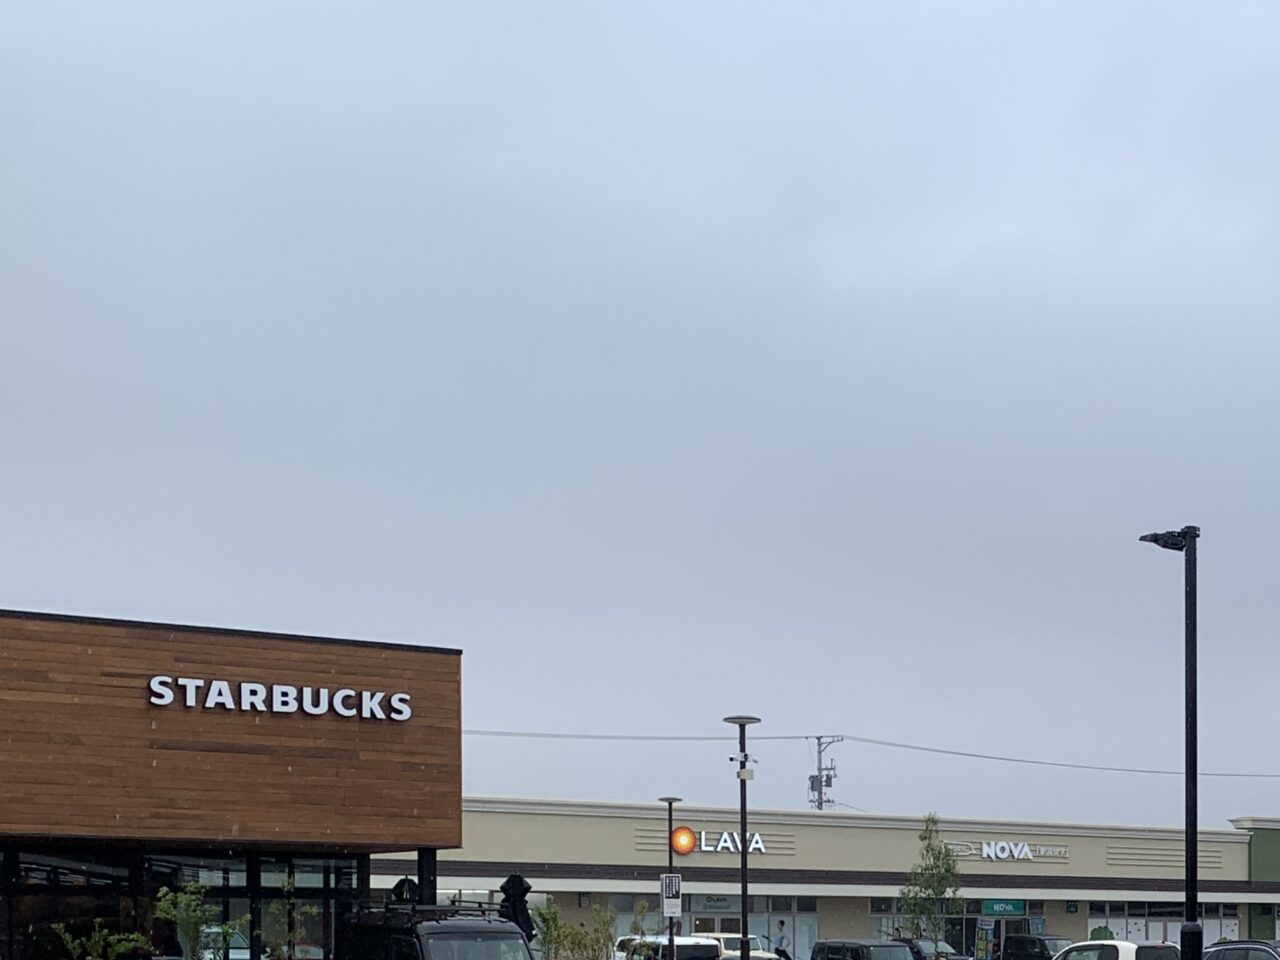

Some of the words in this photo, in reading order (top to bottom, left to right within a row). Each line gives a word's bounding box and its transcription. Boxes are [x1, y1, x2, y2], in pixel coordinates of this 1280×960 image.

[149, 675, 412, 721] STARBUCKS
[701, 830, 766, 852] LAVA
[982, 841, 1033, 861] NOVA
